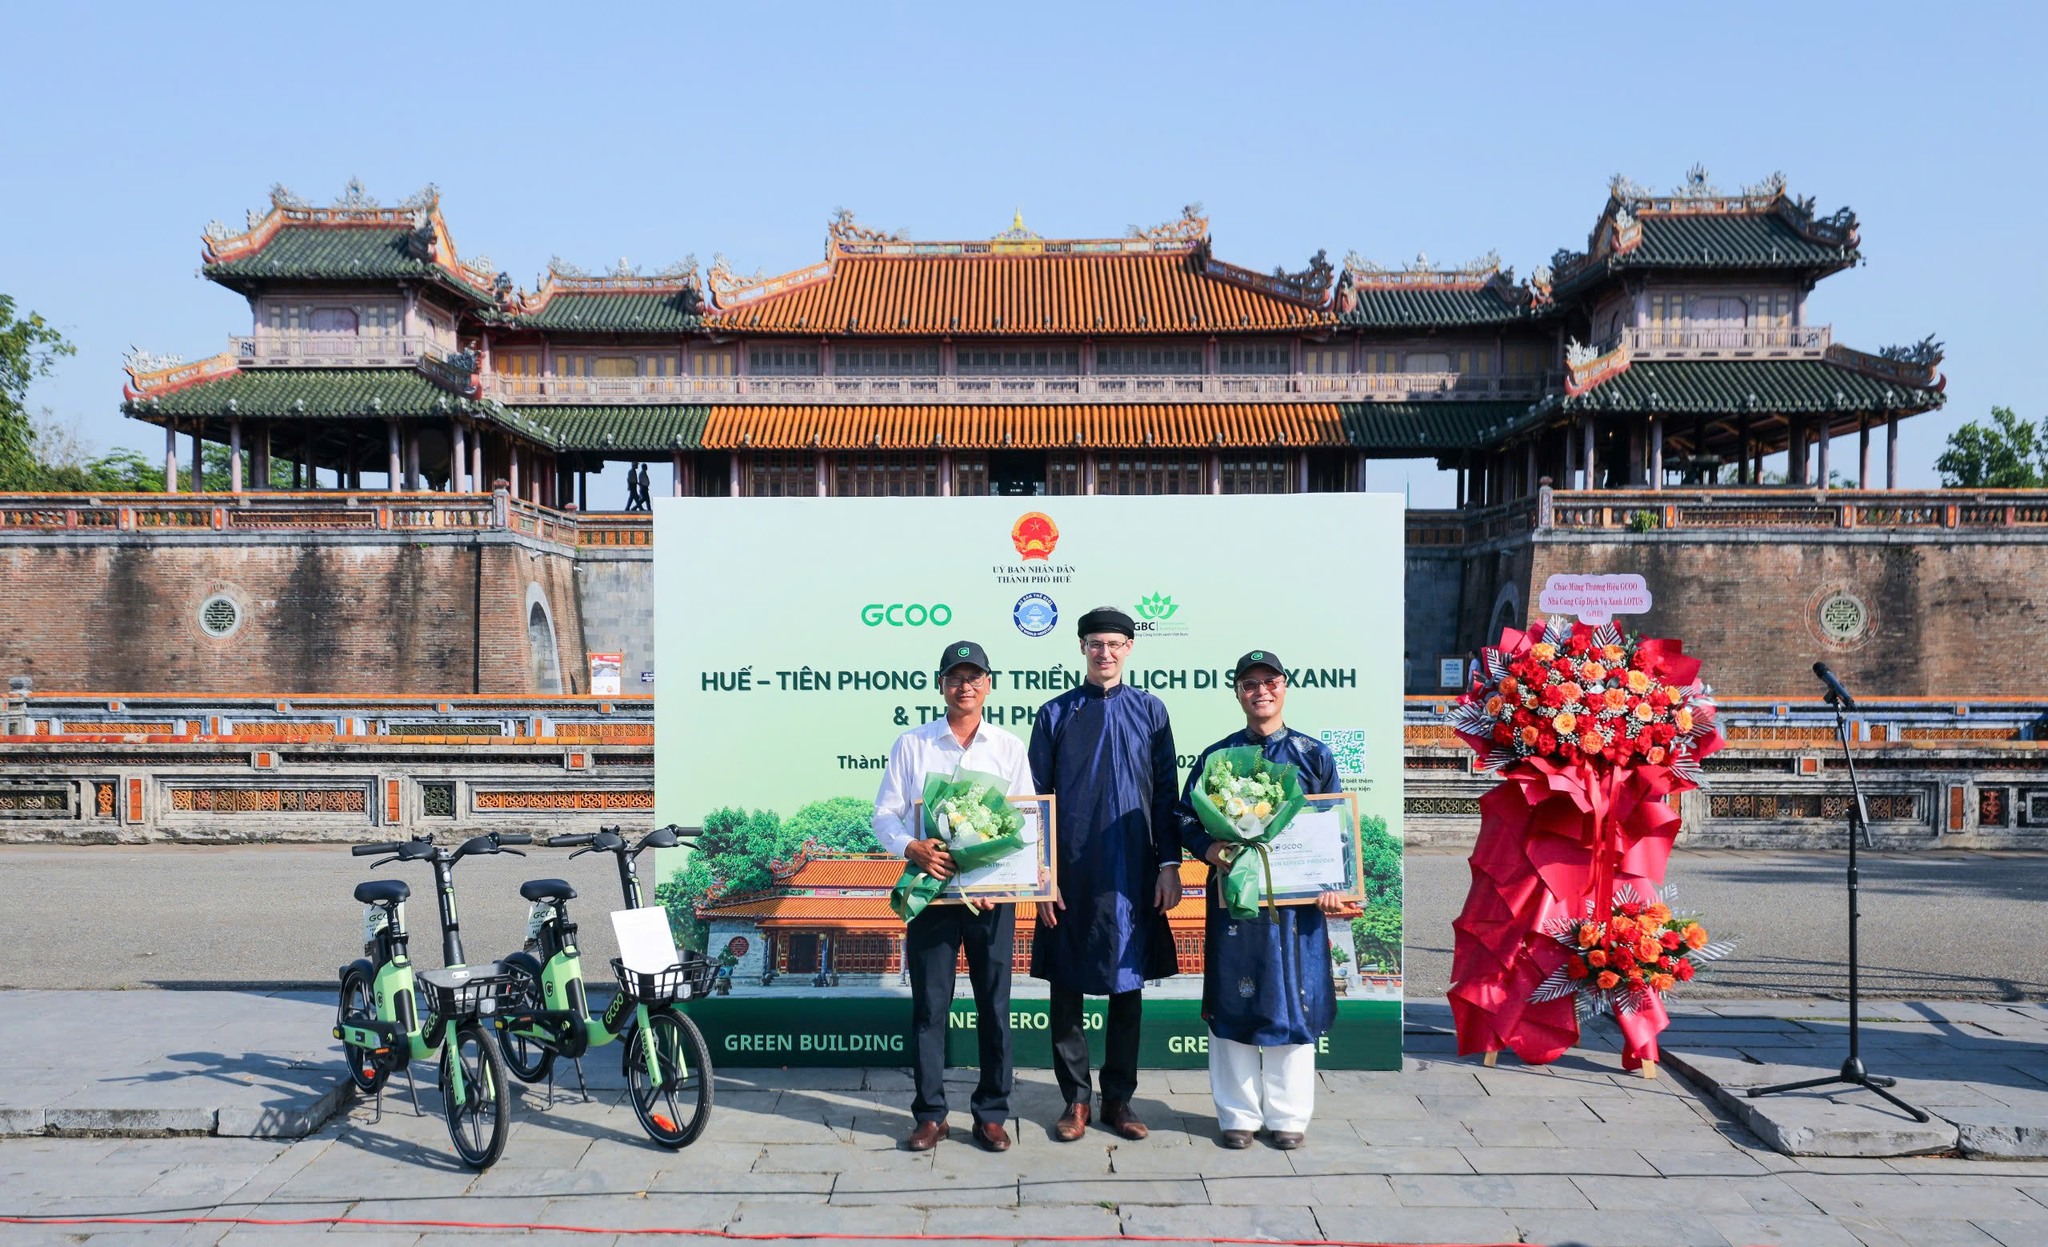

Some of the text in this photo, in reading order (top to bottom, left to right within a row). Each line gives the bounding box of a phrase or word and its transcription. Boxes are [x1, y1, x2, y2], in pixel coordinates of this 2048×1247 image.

[1029, 564, 1054, 573] NHÂN
[1056, 564, 1075, 573] DÂN
[997, 574, 1029, 583] THÀNH
[1621, 582, 1637, 590] GCOO
[1624, 597, 1643, 605] LOTUS
[861, 604, 952, 626] GCOO
[1134, 622, 1155, 631] GBC
[702, 665, 752, 691] HUẾ
[776, 666, 831, 690] TIÊN
[838, 671, 927, 690] PHONG
[1009, 663, 1080, 690] TRIỂN
[1130, 670, 1187, 692] LỊCH
[1194, 669, 1217, 689] DI
[1284, 668, 1356, 688] XANH
[894, 706, 909, 725] &
[605, 993, 624, 1024] GCOO
[949, 1011, 1103, 1030] NE ERO 50
[725, 1034, 904, 1051] GREEN BUILDING
[1168, 1036, 1209, 1053] GRE
